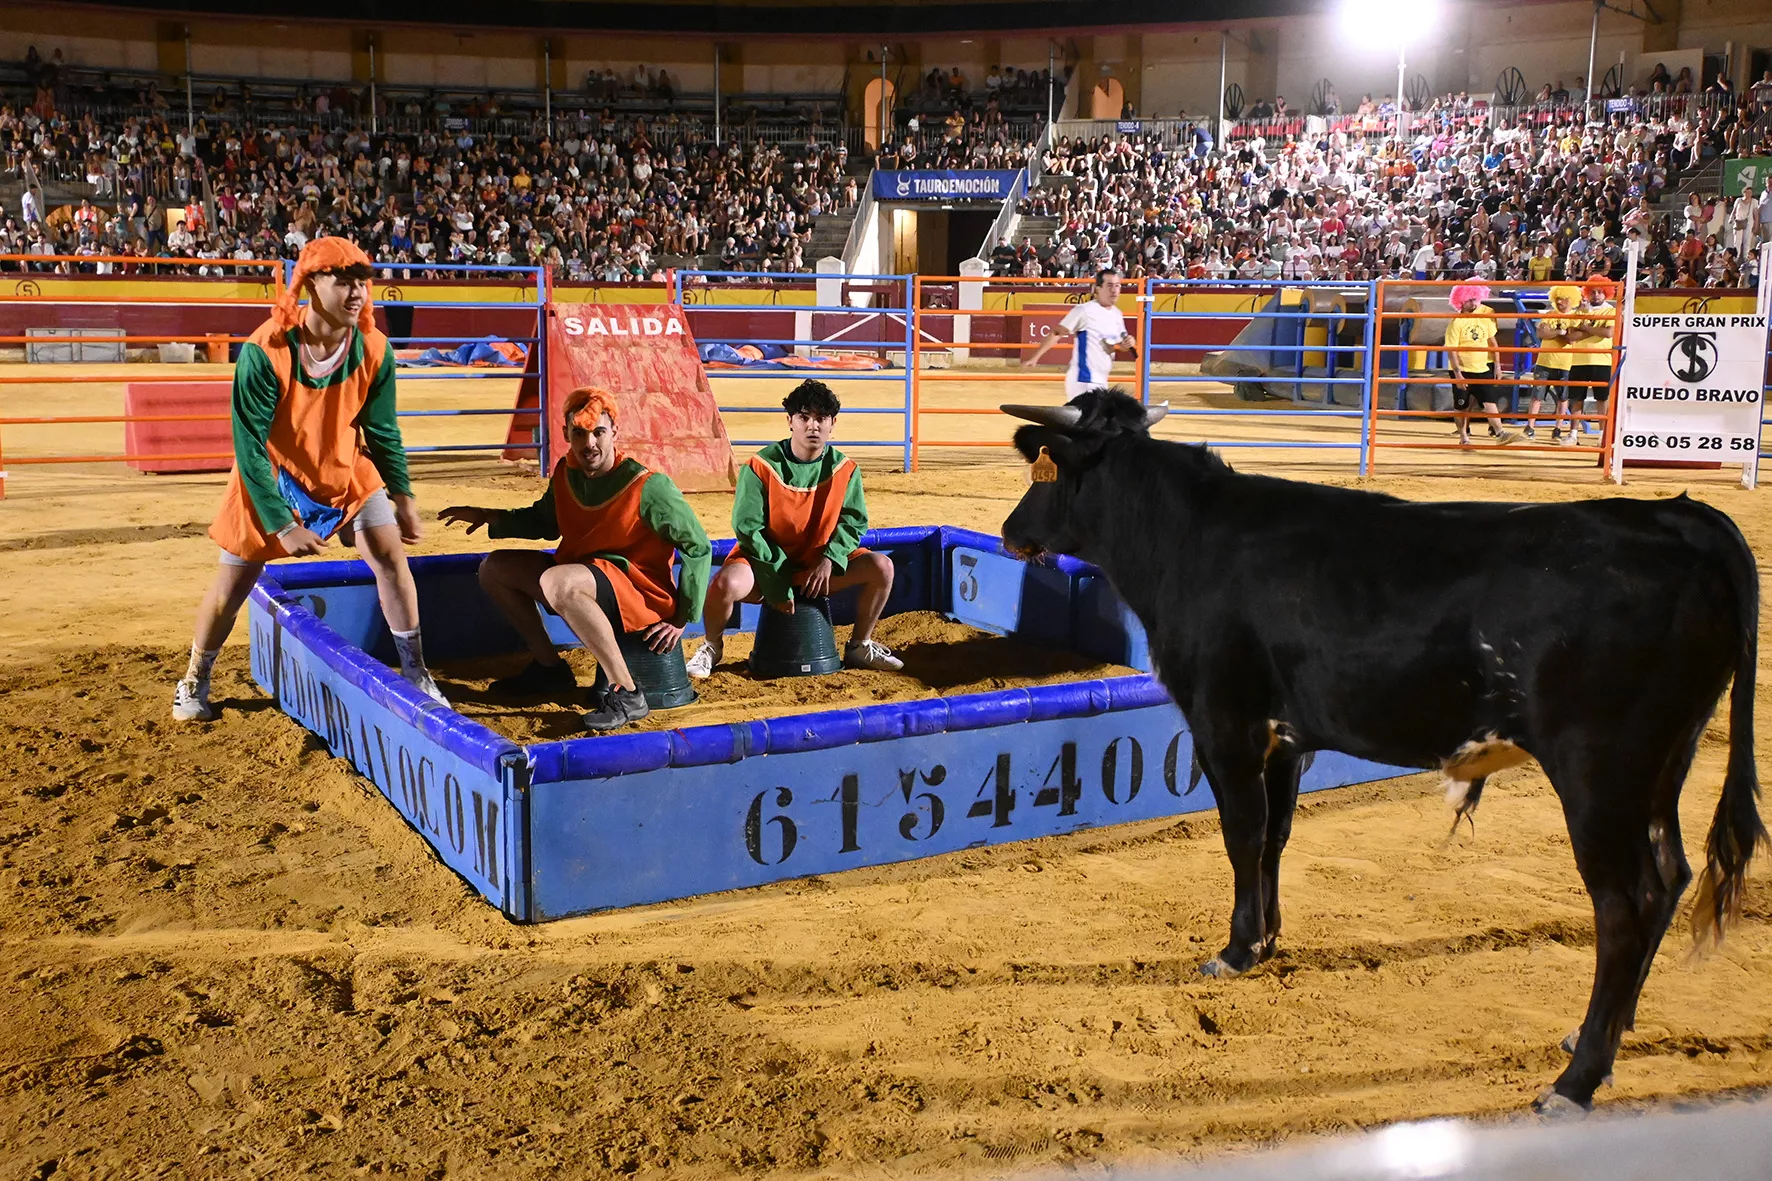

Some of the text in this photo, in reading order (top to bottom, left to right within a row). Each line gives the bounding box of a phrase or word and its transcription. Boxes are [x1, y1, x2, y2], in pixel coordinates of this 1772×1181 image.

[914, 175, 1000, 194] TAUROEMOCIÓN
[564, 317, 686, 336] SALIDA
[1632, 315, 1766, 327] SÚPER GRAN PRIX
[1626, 386, 1759, 403] RUEDO BRAVO
[1622, 434, 1755, 450] 696 05 28 58
[959, 554, 979, 602] 3
